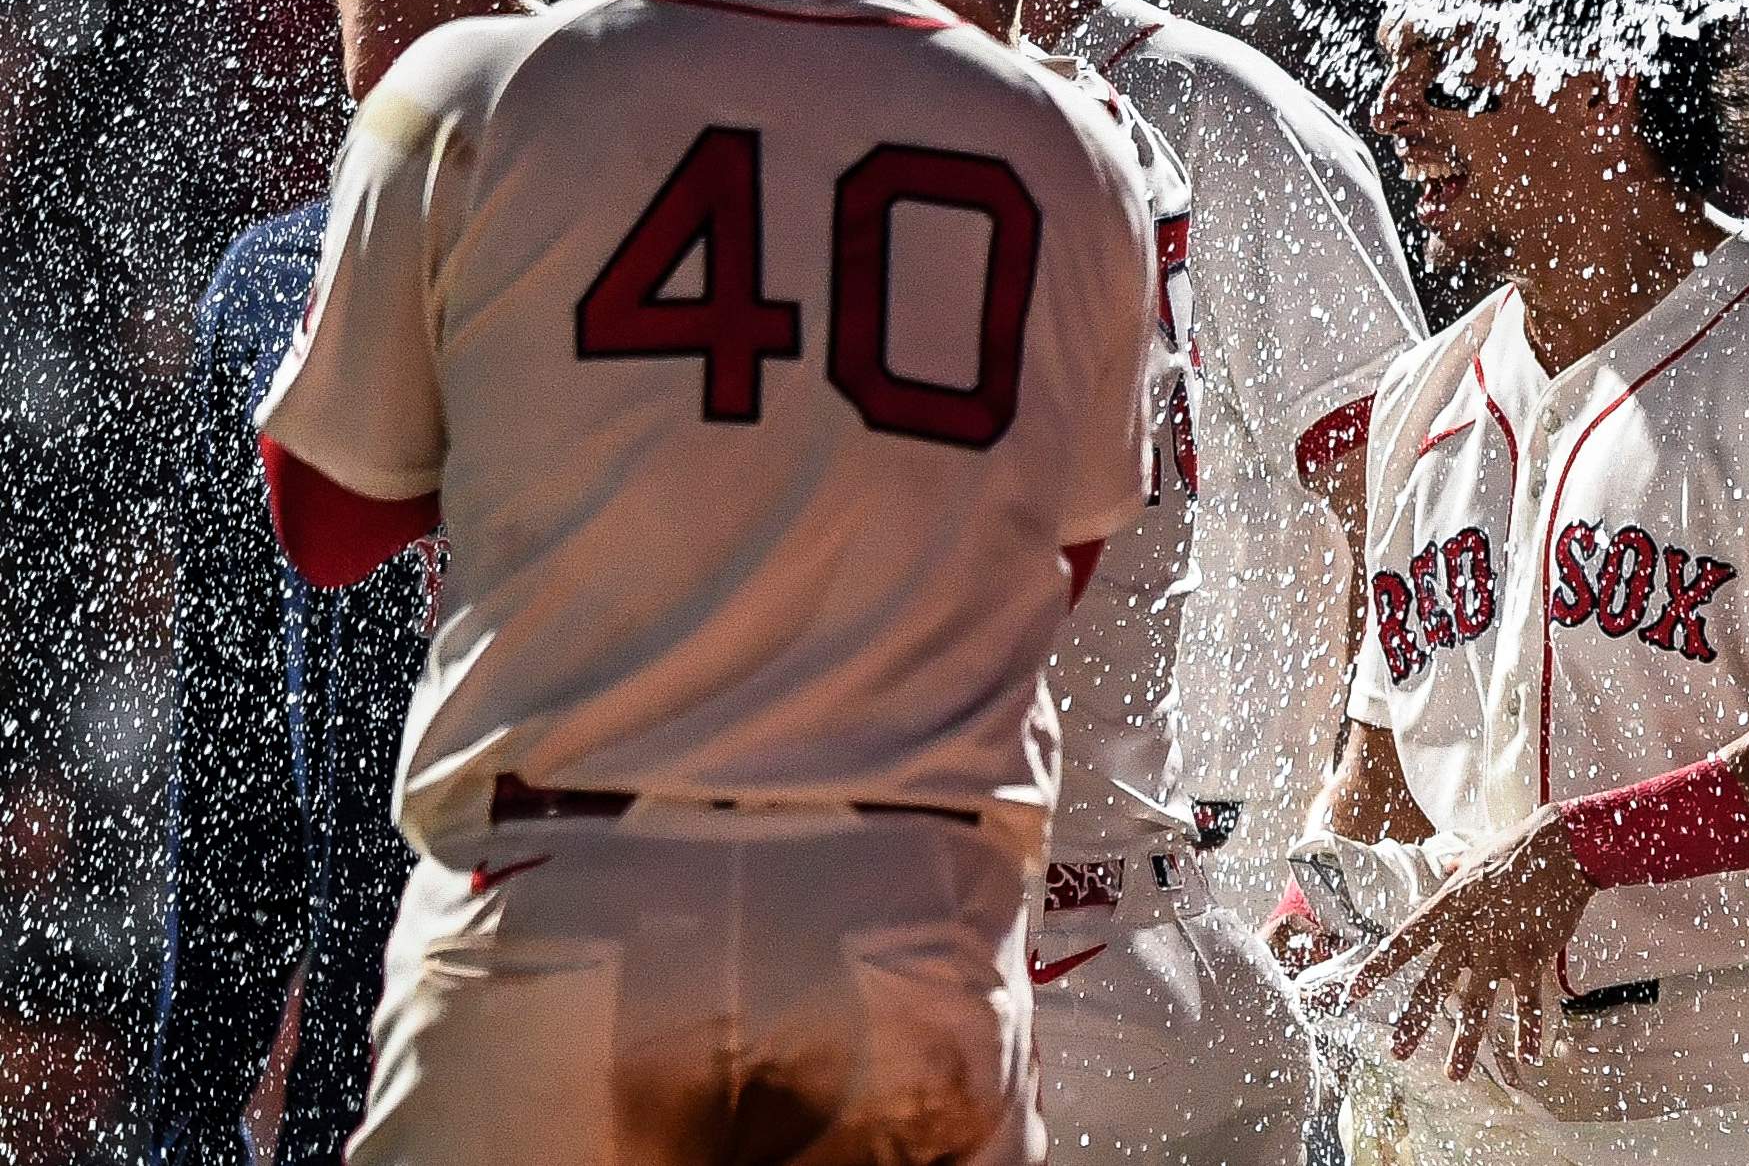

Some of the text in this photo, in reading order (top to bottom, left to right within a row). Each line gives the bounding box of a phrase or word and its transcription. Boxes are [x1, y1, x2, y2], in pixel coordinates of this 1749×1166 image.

[575, 124, 1043, 451] 40
[1372, 518, 1737, 684] RED SOX
